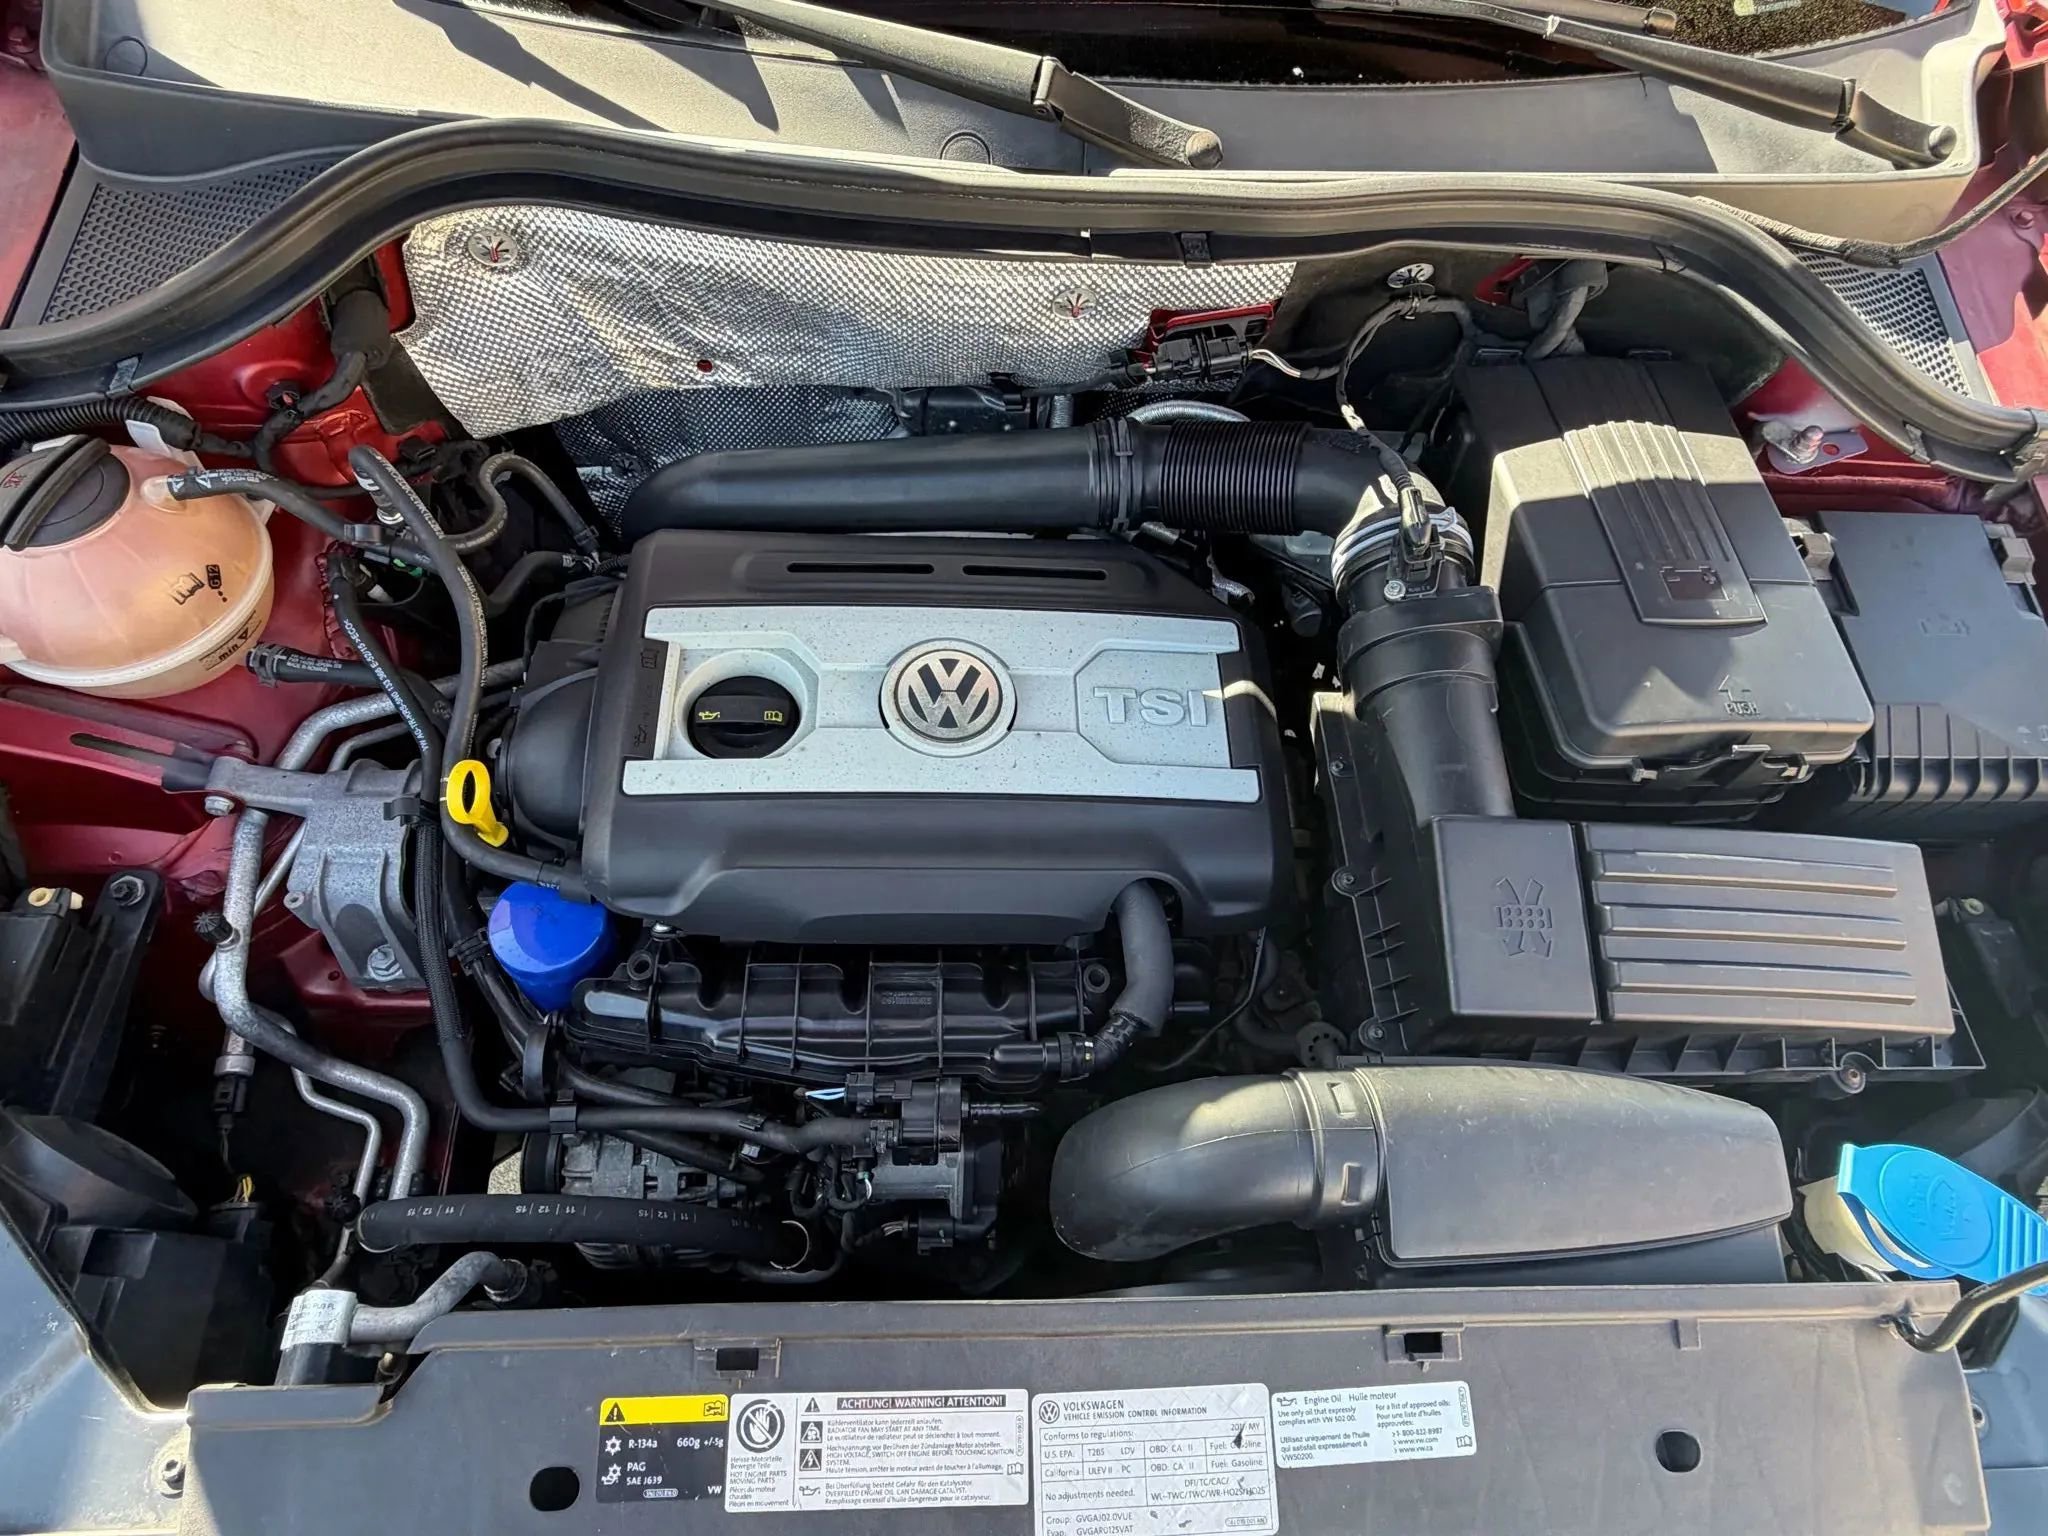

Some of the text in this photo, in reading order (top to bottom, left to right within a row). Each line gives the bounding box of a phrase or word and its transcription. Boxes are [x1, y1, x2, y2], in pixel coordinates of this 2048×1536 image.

[218, 643, 239, 661] min
[1092, 687, 1211, 727] TSI
[1724, 702, 1760, 715] PUSH
[841, 1395, 1003, 1409] ACHTUNG! WARNING! ATTENTION!
[1303, 1391, 1397, 1406] Engine Oil Huile moteur
[1063, 1399, 1124, 1412] VOLKSWAGEN
[1063, 1407, 1207, 1421] VEHICLE EMISSION CONTROL INFORMATION
[1290, 1409, 1304, 1417] only
[1248, 1422, 1260, 1430] MY
[1043, 1431, 1079, 1441] Conforms
[1081, 1431, 1089, 1439] to
[628, 1438, 658, 1449] R-134a
[676, 1437, 701, 1450] 660g
[1120, 1447, 1135, 1456] LDV
[1149, 1445, 1169, 1454] OBD:
[1171, 1444, 1182, 1453] CA
[626, 1461, 647, 1472] PAG
[1088, 1466, 1107, 1475] ULEV
[1121, 1465, 1131, 1473] PC
[1172, 1463, 1184, 1471] CA
[1231, 1458, 1263, 1468] Gasoline
[626, 1475, 663, 1486] SAE J639
[707, 1485, 722, 1495] VW
[1045, 1488, 1136, 1502] No adjustments needed.
